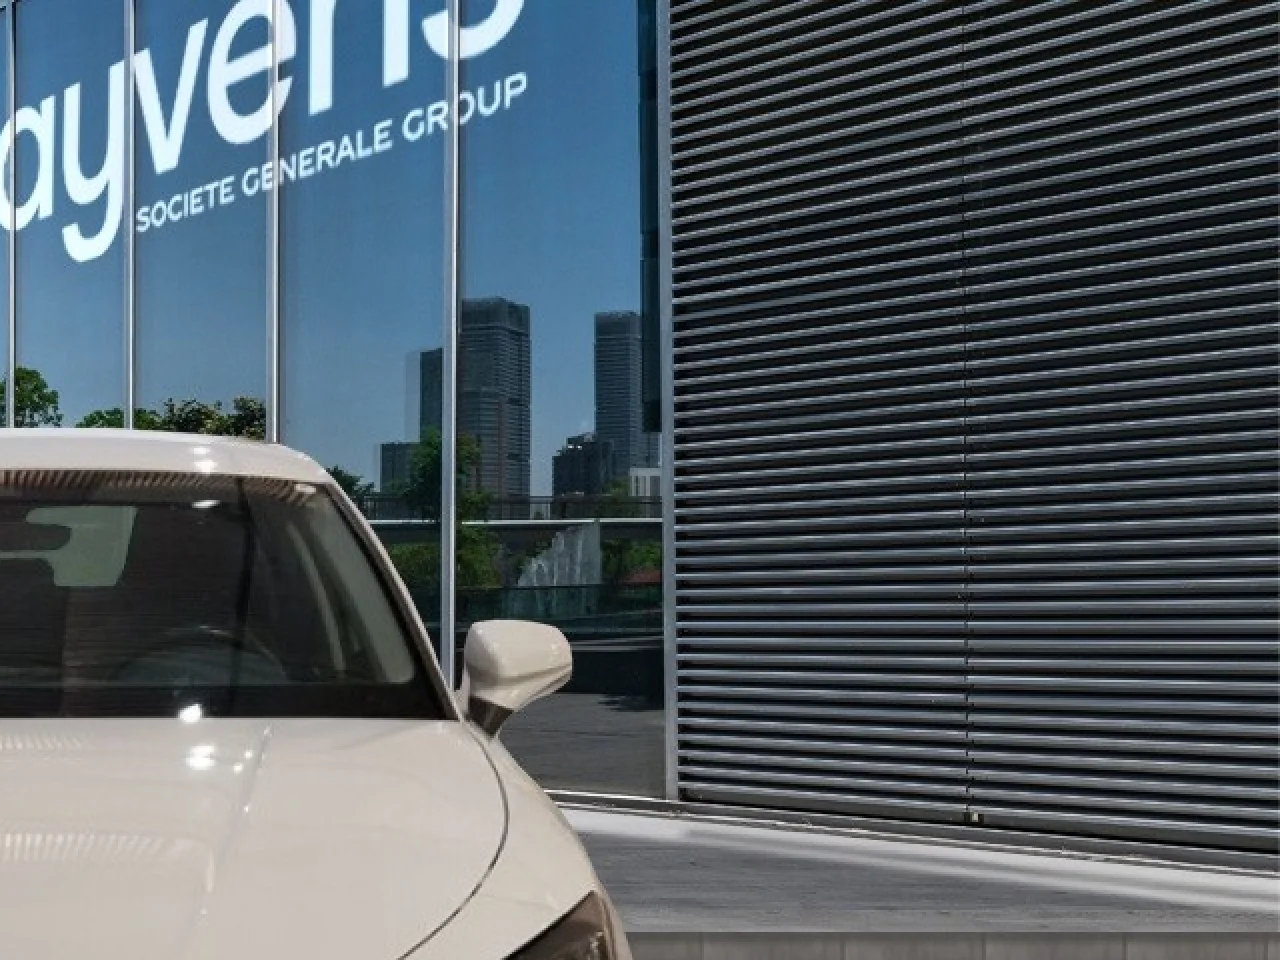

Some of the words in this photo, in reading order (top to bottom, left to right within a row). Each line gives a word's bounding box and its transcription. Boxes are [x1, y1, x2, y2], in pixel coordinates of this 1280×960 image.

[135, 175, 236, 232] SOCIETE
[241, 119, 393, 197] GENERALE
[402, 72, 527, 142] GROUP
